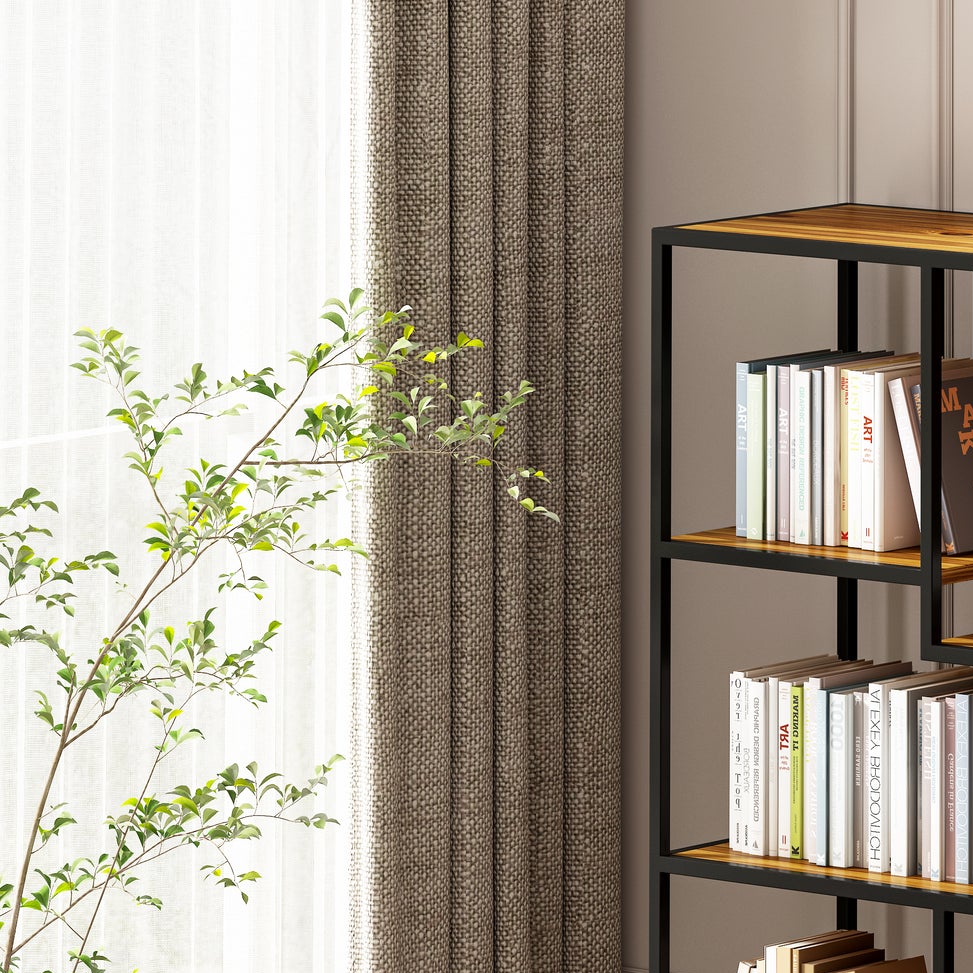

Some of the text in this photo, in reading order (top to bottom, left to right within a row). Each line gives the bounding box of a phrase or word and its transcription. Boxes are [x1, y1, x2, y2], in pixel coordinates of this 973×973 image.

[738, 404, 747, 431] ART
[779, 408, 788, 435] ART
[863, 416, 873, 444] ART
